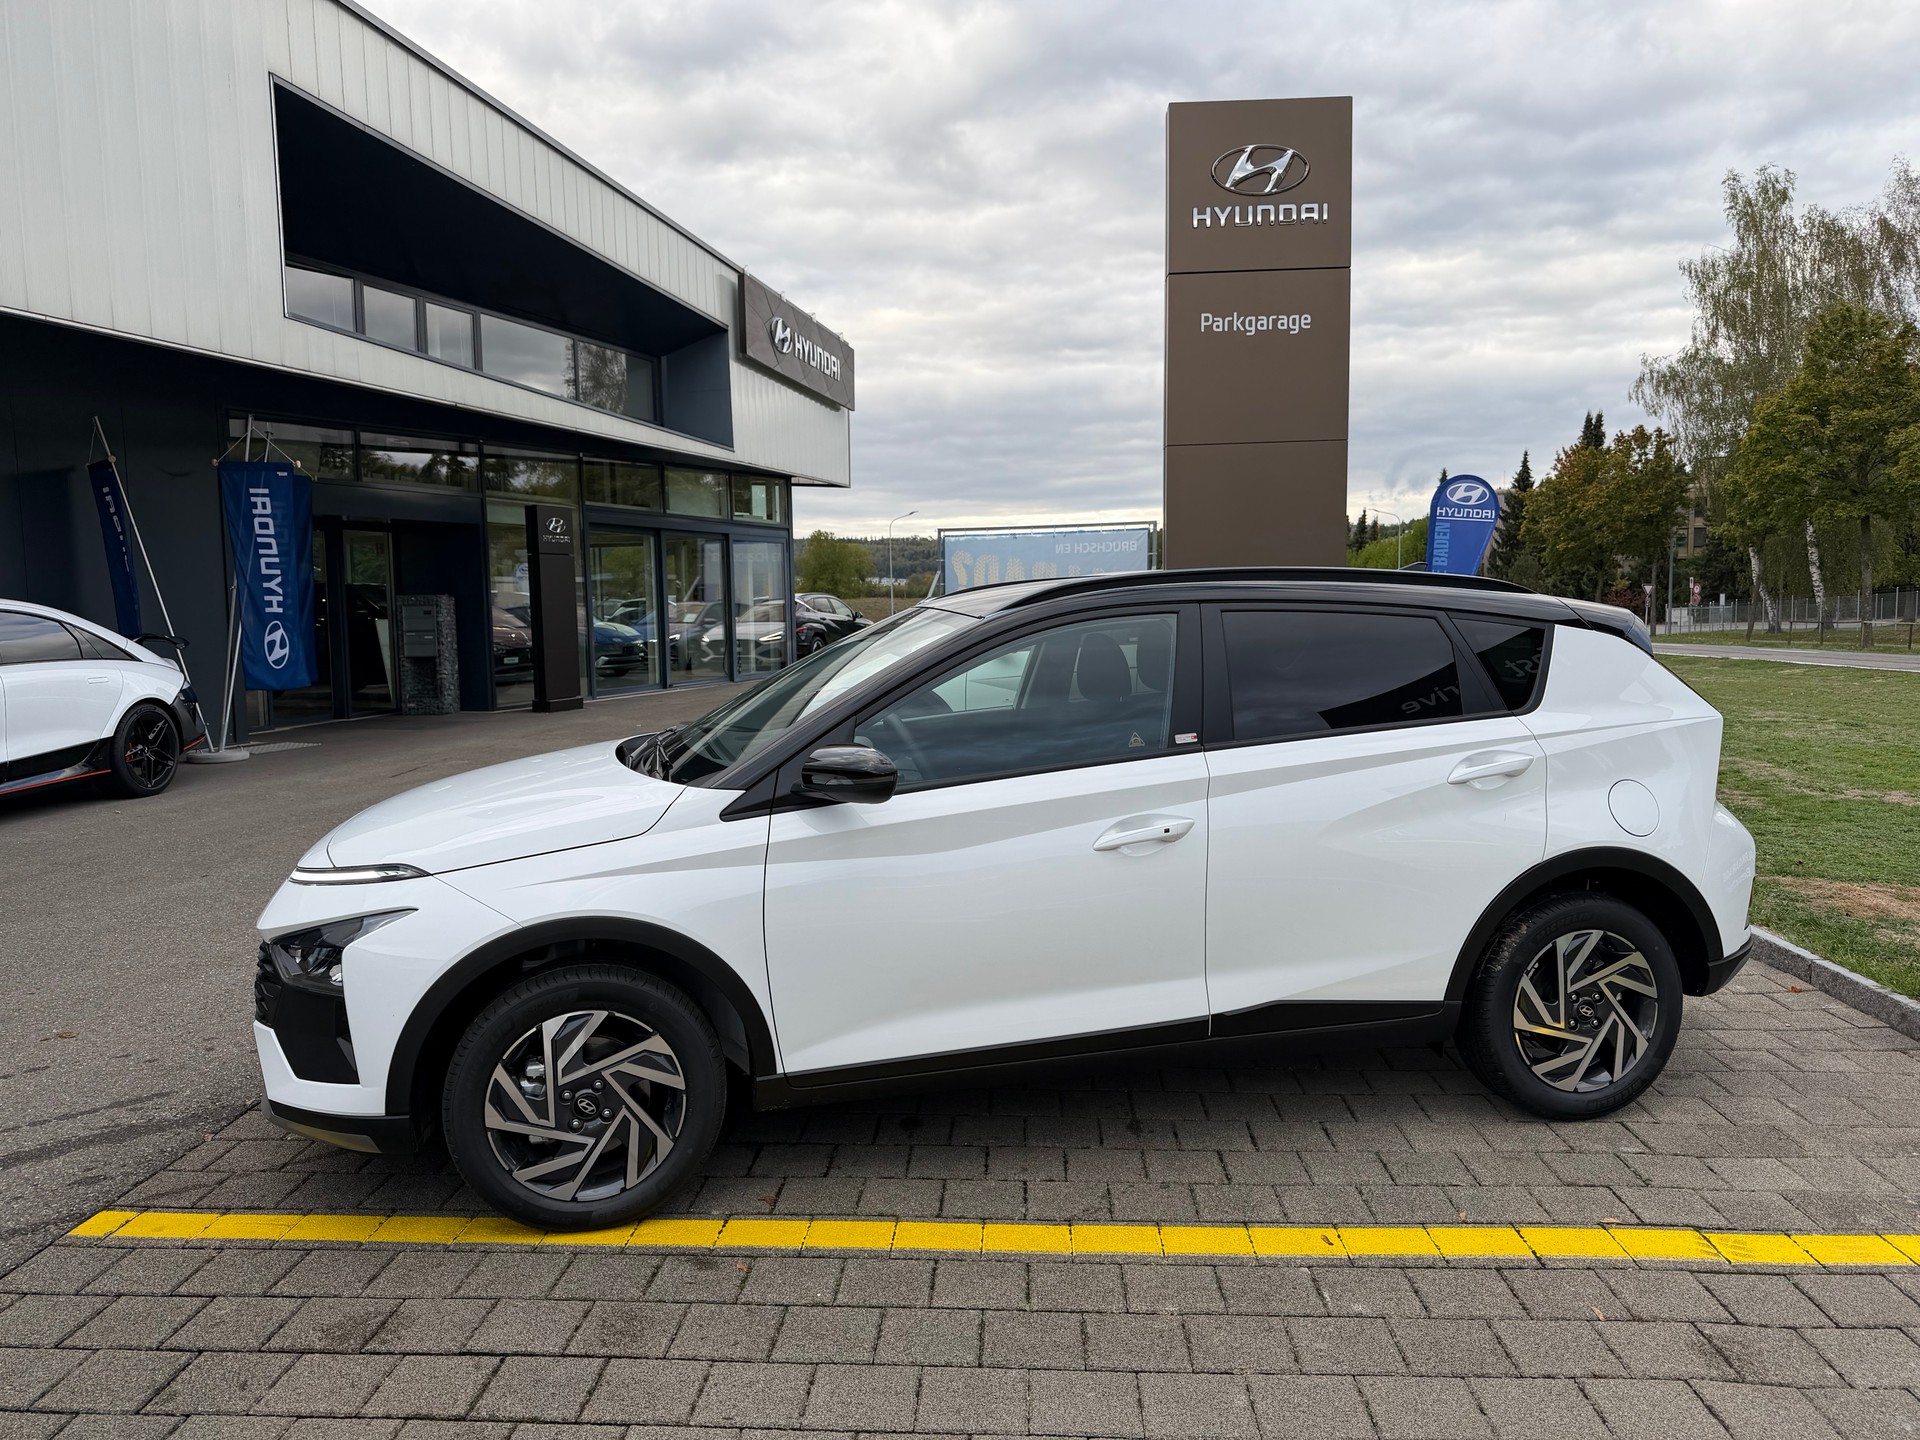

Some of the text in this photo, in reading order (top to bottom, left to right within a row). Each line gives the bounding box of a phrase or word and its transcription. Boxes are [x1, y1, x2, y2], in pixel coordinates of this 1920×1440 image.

[1192, 202, 1329, 228] HYUNDAI
[1201, 312, 1312, 336] Parkgarage
[794, 331, 841, 382] HYUNDAI
[1436, 506, 1496, 519] HYUNDAI
[1432, 522, 1451, 566] BADEN
